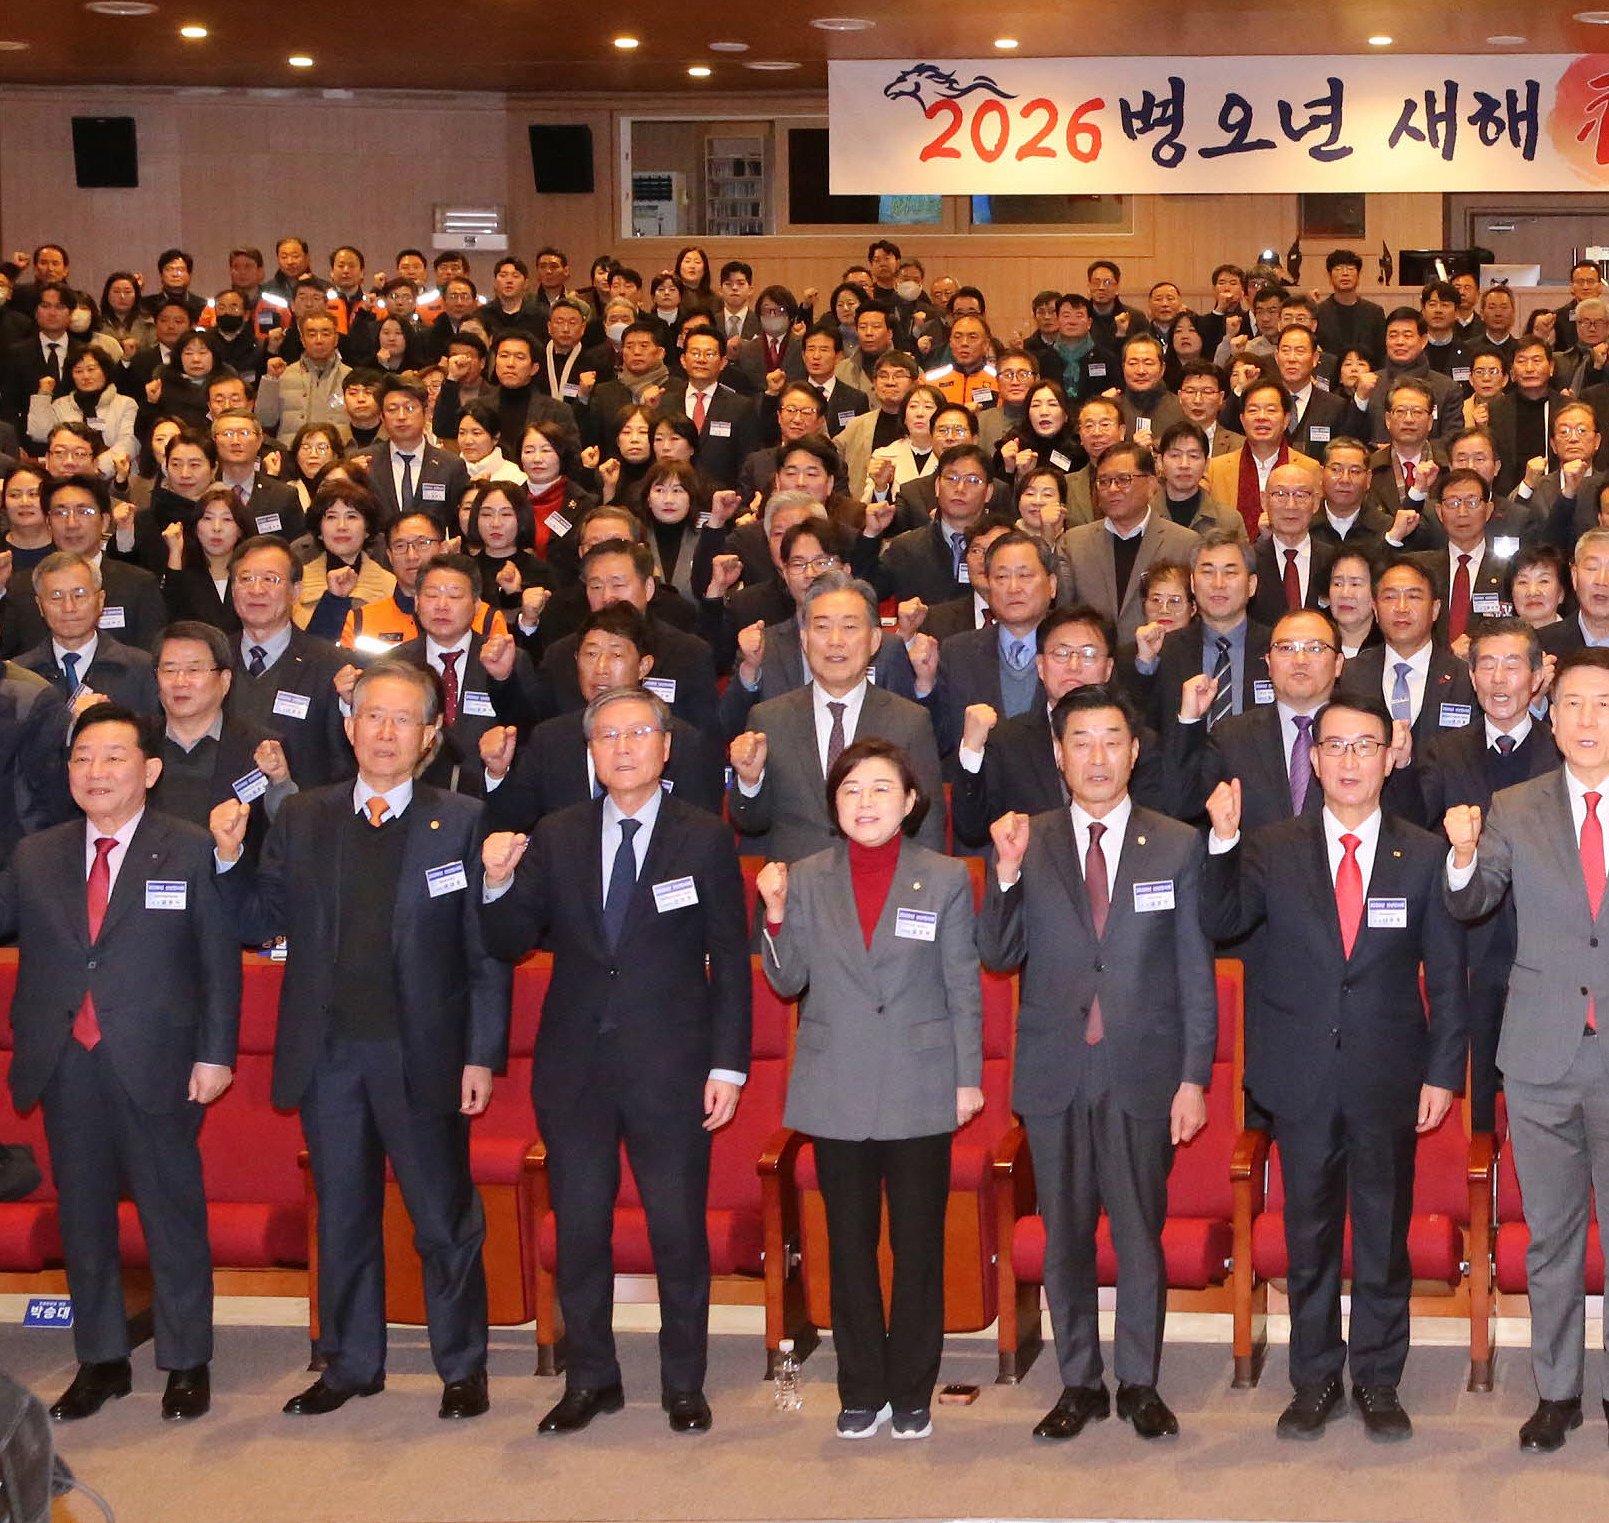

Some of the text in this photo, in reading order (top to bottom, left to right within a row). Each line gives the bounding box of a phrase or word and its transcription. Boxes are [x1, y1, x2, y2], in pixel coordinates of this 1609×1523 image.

[919, 97, 1105, 163] 2026
[1118, 76, 1354, 169] 병오년
[1388, 79, 1542, 162] 새해
[30, 1305, 71, 1320] 박승대
